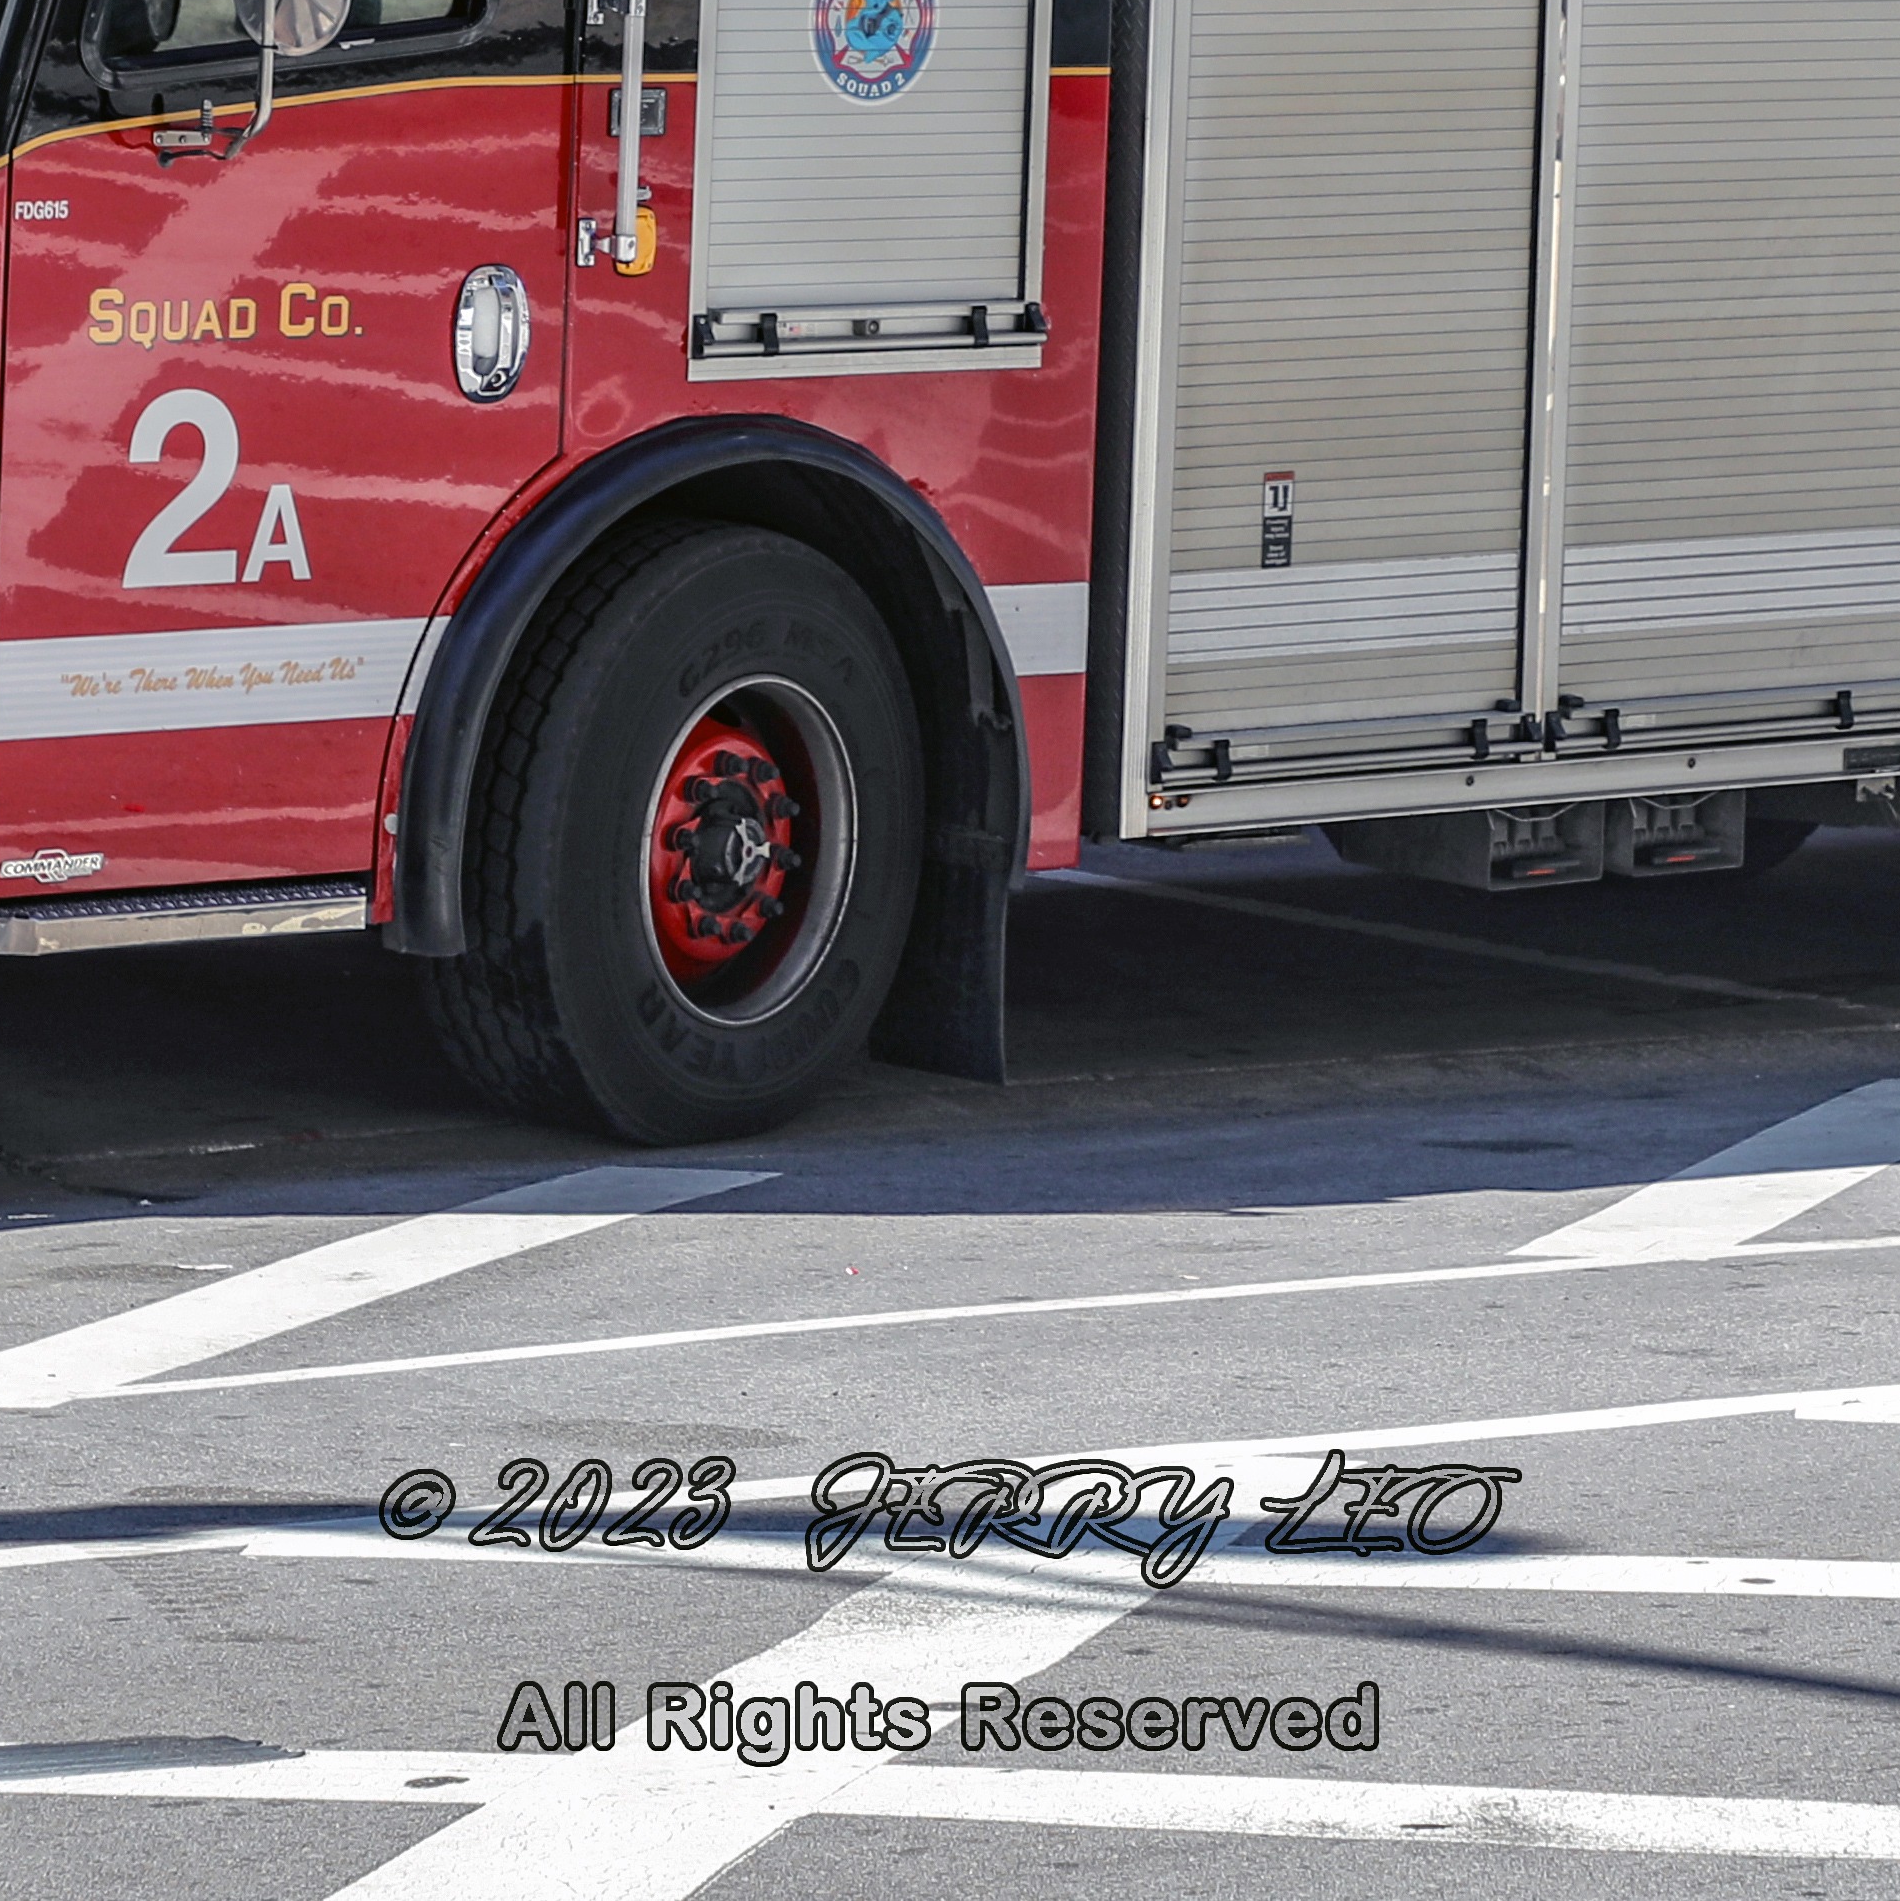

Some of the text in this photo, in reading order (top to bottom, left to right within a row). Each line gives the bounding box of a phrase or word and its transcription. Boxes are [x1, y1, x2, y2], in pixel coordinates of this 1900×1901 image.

[836, 72, 906, 97] SQUAD 2
[13, 199, 70, 221] FDG615
[88, 282, 364, 351] SQUAD CO.
[121, 387, 313, 590] 2A
[129, 666, 178, 694] There
[184, 665, 235, 691] When
[239, 662, 275, 695] You
[279, 660, 326, 686] Need
[3, 856, 100, 875] COMMANDER
